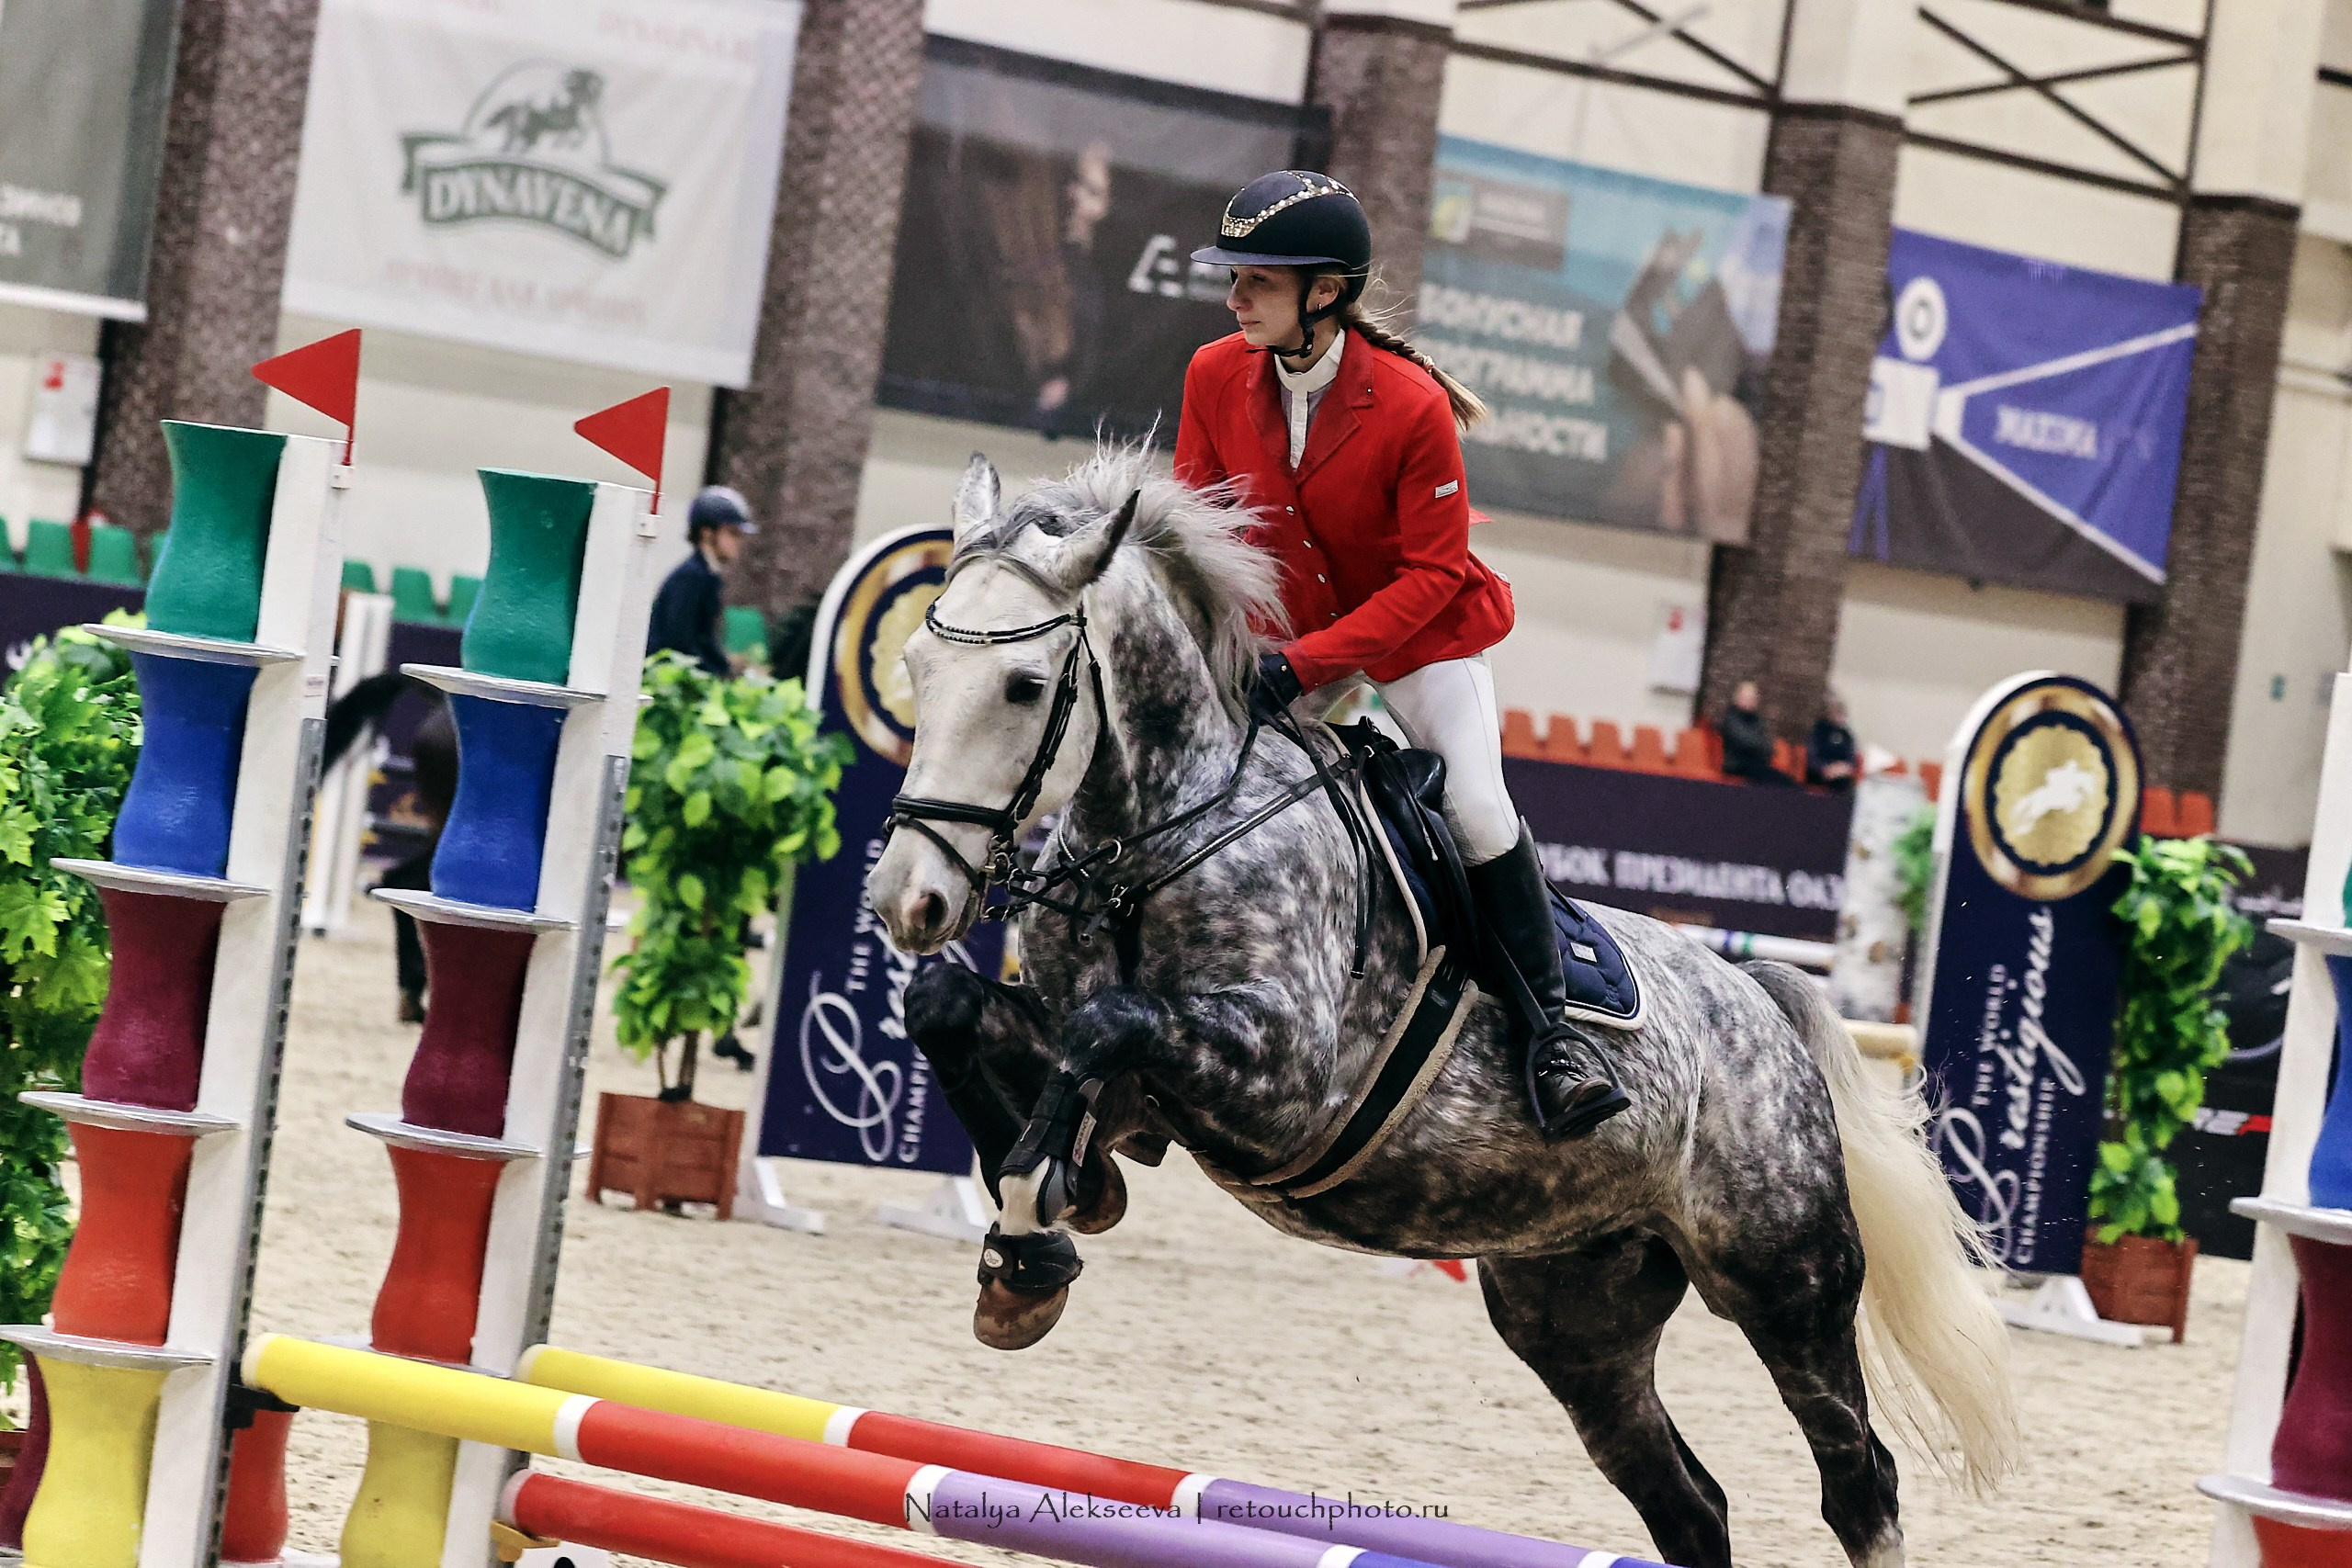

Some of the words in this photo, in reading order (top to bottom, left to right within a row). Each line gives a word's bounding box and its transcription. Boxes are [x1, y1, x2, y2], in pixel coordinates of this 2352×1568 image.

[428, 169, 632, 253] DYNAVENA
[854, 838, 885, 933] WOLD
[845, 943, 871, 992] THE
[1979, 962, 2007, 1051] WORLD
[896, 1043, 931, 1163] CHAMPI
[1930, 905, 2086, 1264] Prestigious
[1972, 1060, 1995, 1106] THE
[2015, 1077, 2055, 1264] CHAMPIONSHIP
